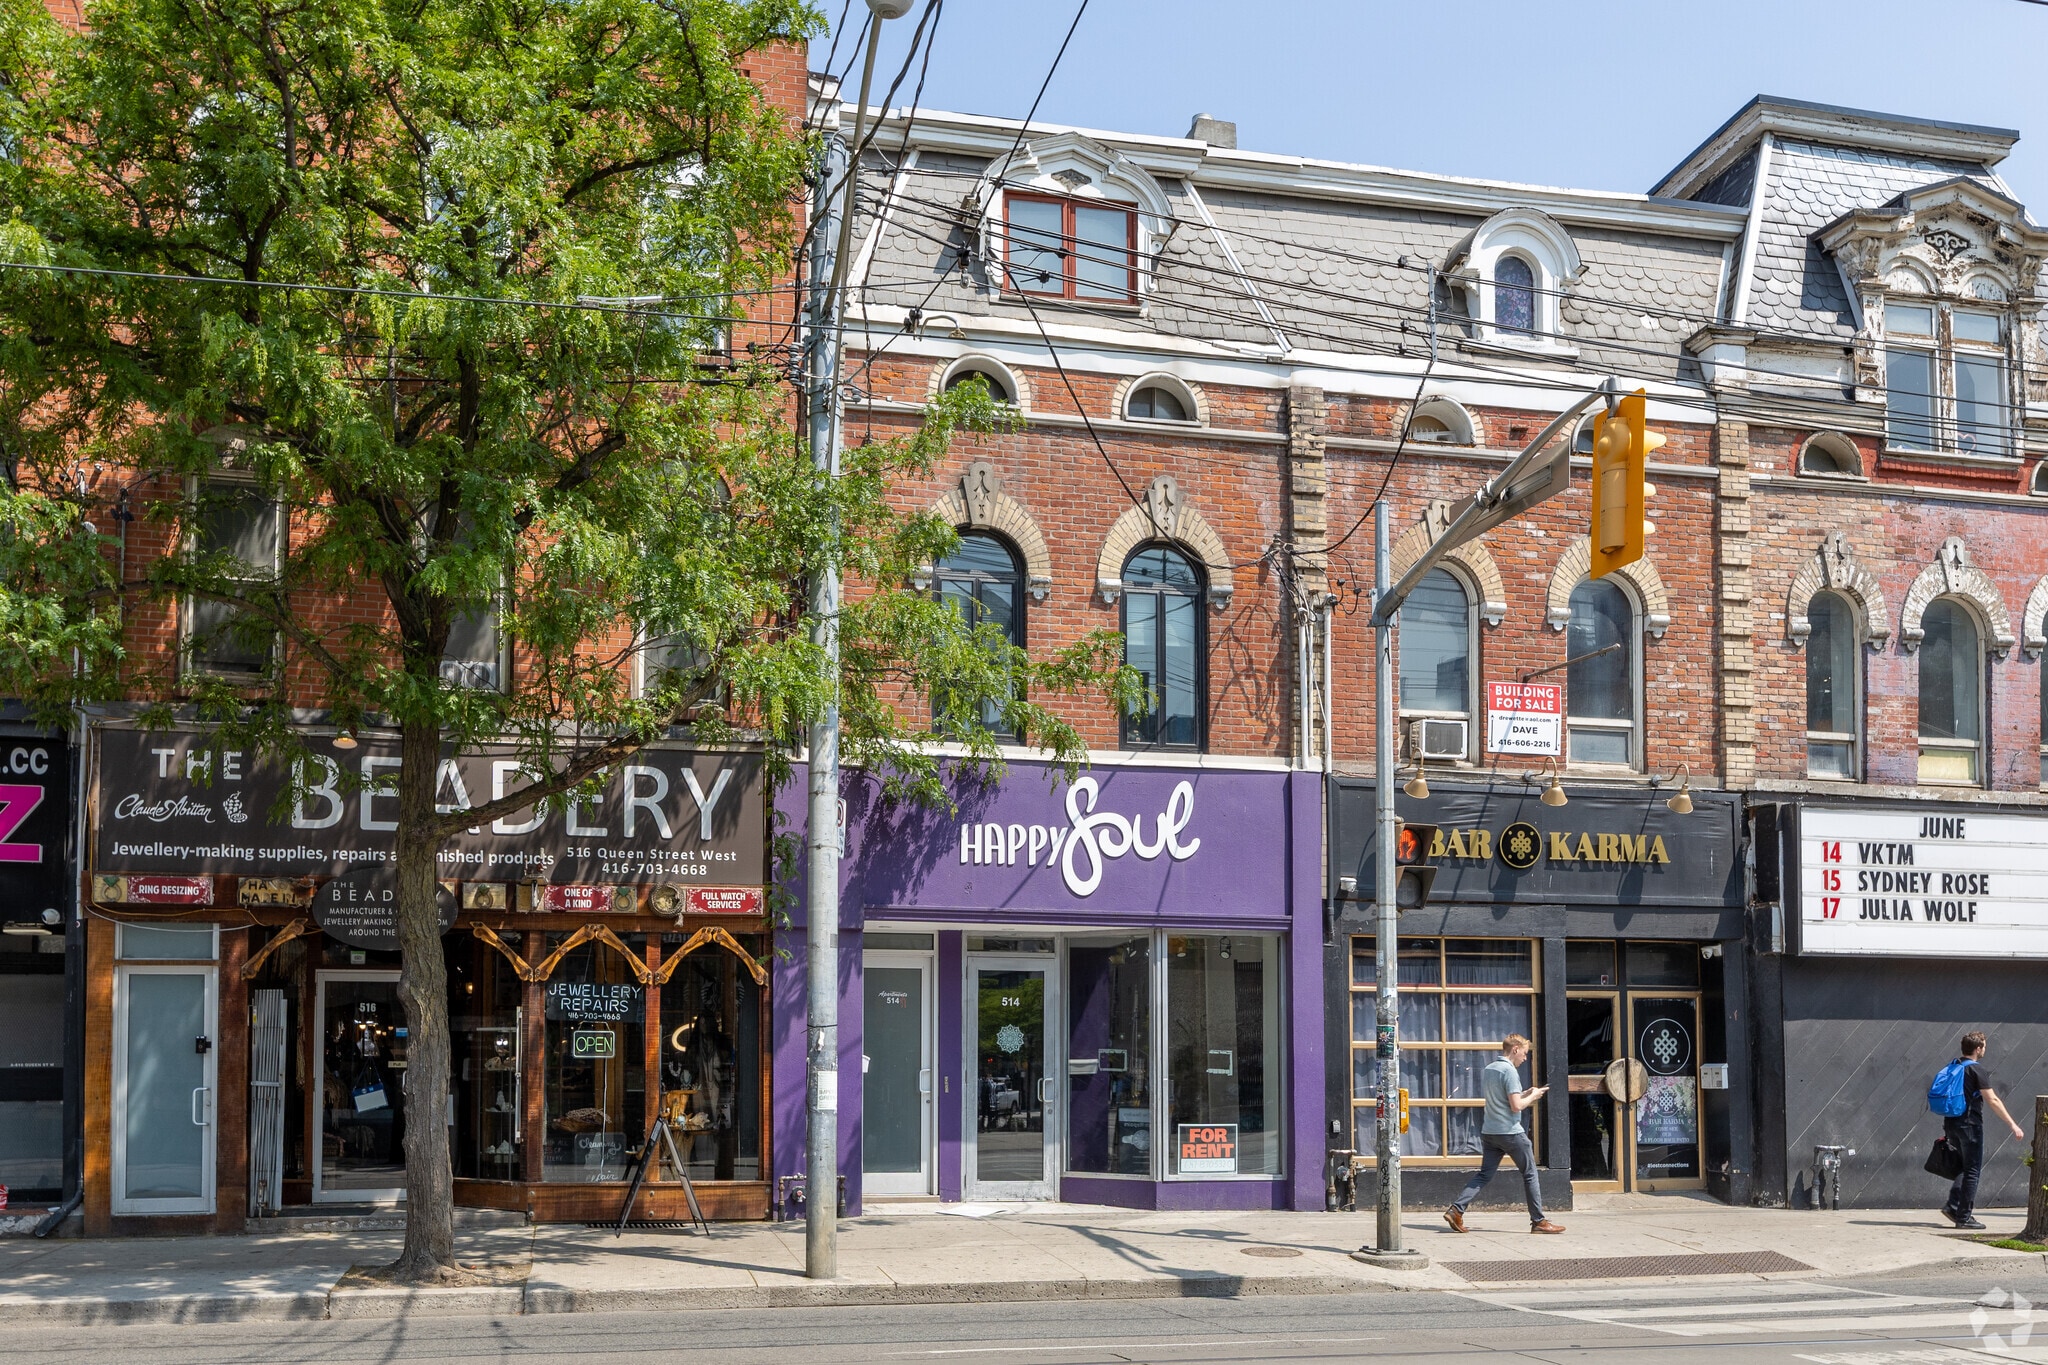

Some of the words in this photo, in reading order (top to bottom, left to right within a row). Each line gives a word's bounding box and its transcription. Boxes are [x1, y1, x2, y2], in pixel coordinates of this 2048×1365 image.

[1495, 685, 1554, 698] BUILDING
[1496, 698, 1521, 709] FOR
[1525, 699, 1554, 710] SALE
[1512, 726, 1538, 734] DAVE
[1498, 739, 1551, 748] 416-606-2216
[0, 747, 49, 775] .CC
[151, 748, 242, 780] THE
[291, 753, 733, 841] BEADERY
[114, 793, 165, 820] Claude
[1919, 817, 1966, 839] JUNE
[960, 822, 1068, 867] HAPPY
[1061, 776, 1201, 897] Soul
[1427, 828, 1494, 859] BAR
[1549, 831, 1672, 864] KARMA
[112, 841, 255, 861] Jewellery-making
[258, 844, 328, 864] supplies,
[332, 847, 387, 866] repairs
[488, 850, 555, 867] products
[566, 847, 591, 858] 516
[597, 847, 644, 860] Queen
[650, 848, 695, 860] Street
[701, 850, 737, 861] West
[1822, 841, 1842, 863] 14
[1858, 842, 1914, 866] VKTM
[602, 862, 708, 876] 416-703-4668
[1822, 869, 1842, 892] 15
[1858, 870, 1932, 894] SYDNEY
[1941, 873, 1989, 895] ROSE
[138, 884, 160, 894] RING
[161, 885, 200, 896] RESIZING
[564, 888, 580, 897] ONE
[581, 888, 593, 897] OF
[701, 892, 719, 900] FULL
[720, 892, 746, 901] WATCH
[329, 907, 386, 915] MANUFACTURER
[387, 907, 393, 915] &
[564, 900, 571, 908] A
[572, 900, 593, 909] KIND
[707, 900, 742, 909] SERVICES
[1821, 897, 1841, 919] 17
[1859, 898, 1914, 921] JULIA
[1923, 900, 1977, 922] WOLF
[323, 918, 361, 926] JEWELLERY
[363, 918, 392, 926] MAKING
[348, 928, 380, 936] AROUND
[382, 928, 396, 936] THE
[548, 983, 641, 999] JEWELLERY
[359, 1002, 377, 1012] 516
[560, 997, 629, 1013] REPAIRS
[1001, 997, 1020, 1007] 514
[567, 1012, 621, 1020] 416-703-4668
[575, 1036, 613, 1052] OPEN
[1189, 1127, 1228, 1143] FOR
[1182, 1143, 1235, 1158] RENT
